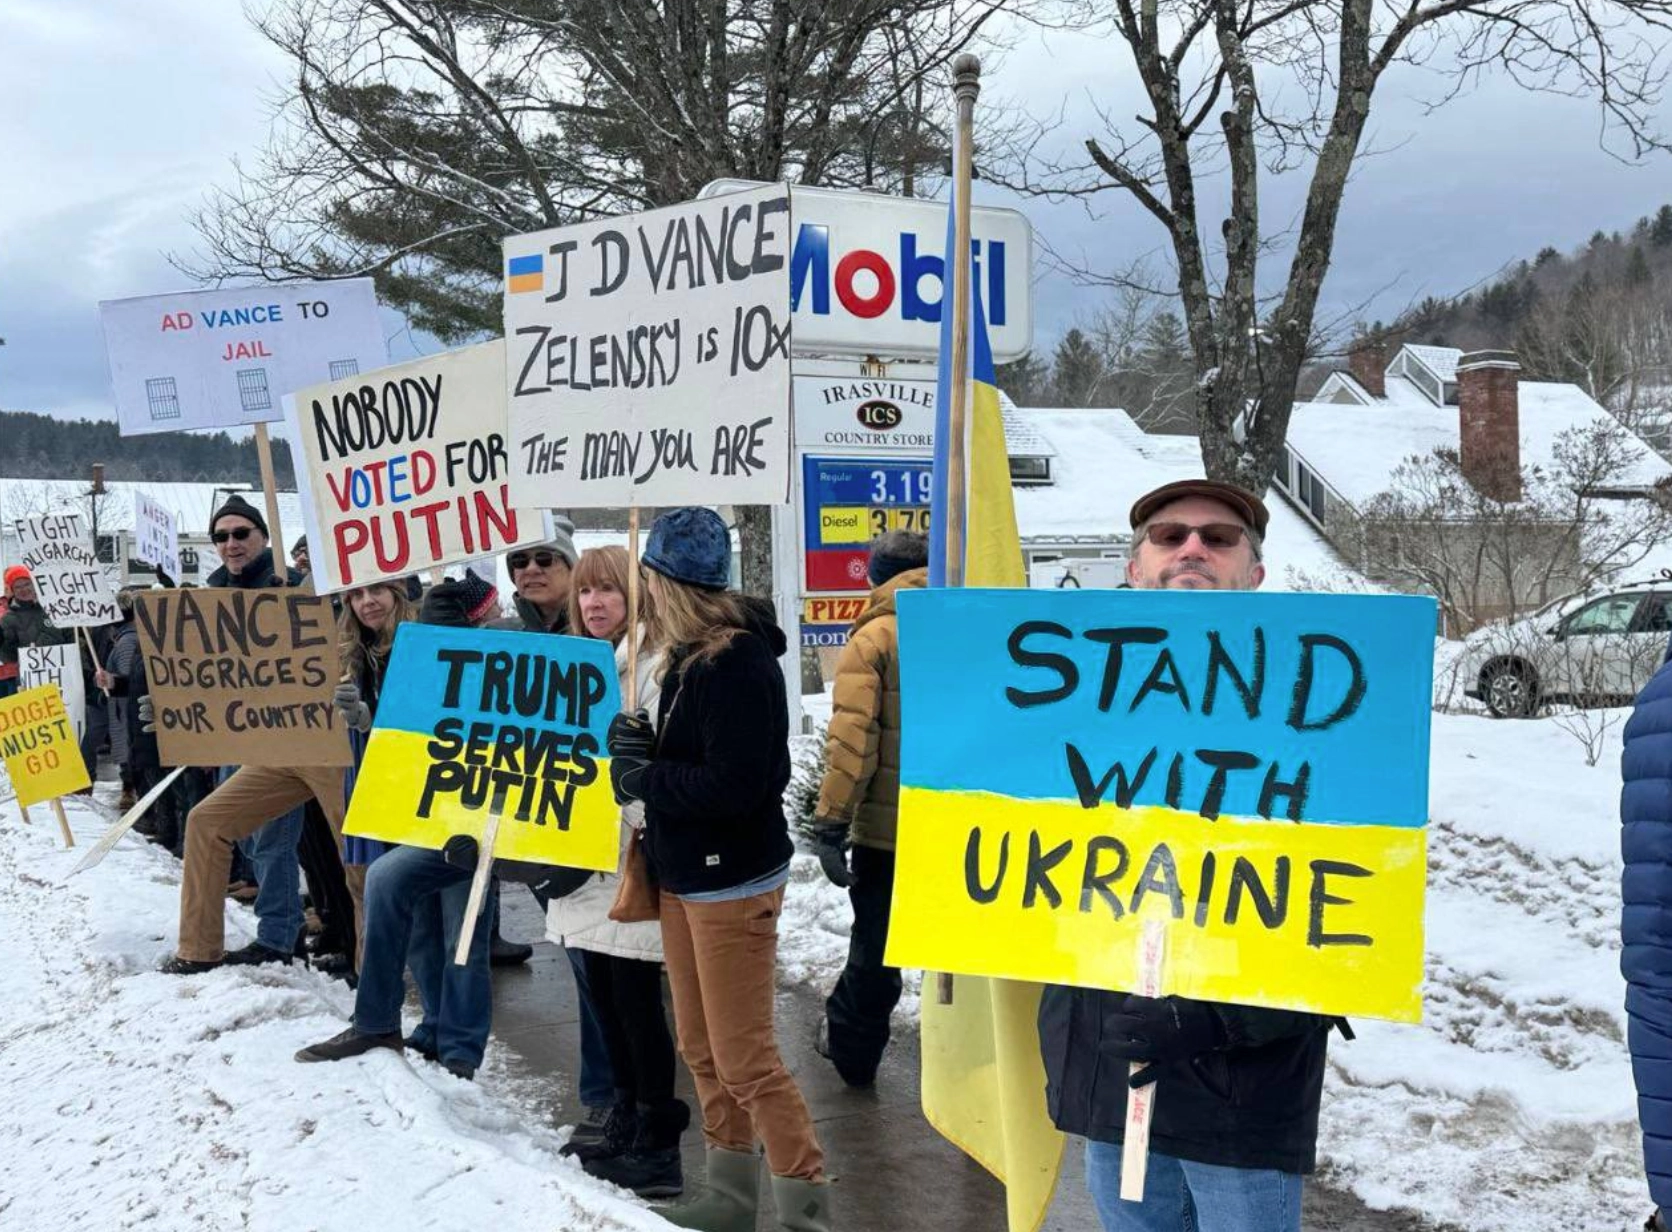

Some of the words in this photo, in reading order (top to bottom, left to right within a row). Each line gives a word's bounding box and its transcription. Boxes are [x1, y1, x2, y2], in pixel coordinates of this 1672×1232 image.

[545, 240, 578, 303] J
[590, 230, 630, 297] D
[638, 197, 790, 294] VANCE
[161, 311, 193, 332] AD
[201, 304, 283, 329] VANCE
[297, 301, 329, 319] TO
[222, 341, 272, 361] JAIL
[514, 318, 681, 397] ZELENSKY
[823, 382, 934, 408] IRASVILLE
[312, 374, 442, 461] NOBODY
[863, 407, 897, 424] ICS
[522, 433, 568, 474] THE
[581, 431, 642, 480] MAN
[634, 428, 698, 485] YOU
[710, 417, 773, 477] ARE
[824, 432, 889, 445] COUNTRY
[893, 433, 934, 446] STORE
[326, 450, 437, 513] VOTED
[446, 433, 508, 487] FOR
[820, 472, 852, 484] Regular
[871, 470, 934, 502] 3.19
[15, 515, 78, 543] FIGHT
[334, 485, 518, 585] PUTIN
[822, 515, 858, 528] Diesel
[23, 542, 96, 572] OLIGARCHY
[35, 571, 99, 596] FIGHT
[135, 589, 328, 656] VANCE
[811, 600, 866, 620] PIZZ
[27, 646, 65, 670] SKI
[150, 656, 327, 689] DISGRACES
[437, 649, 606, 728] TRUMP
[1005, 620, 1368, 731] STAND
[162, 701, 214, 732] OUR
[226, 701, 335, 732] COUNTRY
[2, 719, 67, 757] MUST
[427, 717, 599, 787] SERVES
[26, 749, 60, 775] GO
[416, 760, 577, 831] PUTIN
[1065, 743, 1312, 823] WITH
[964, 826, 1374, 949] UKRAINE
